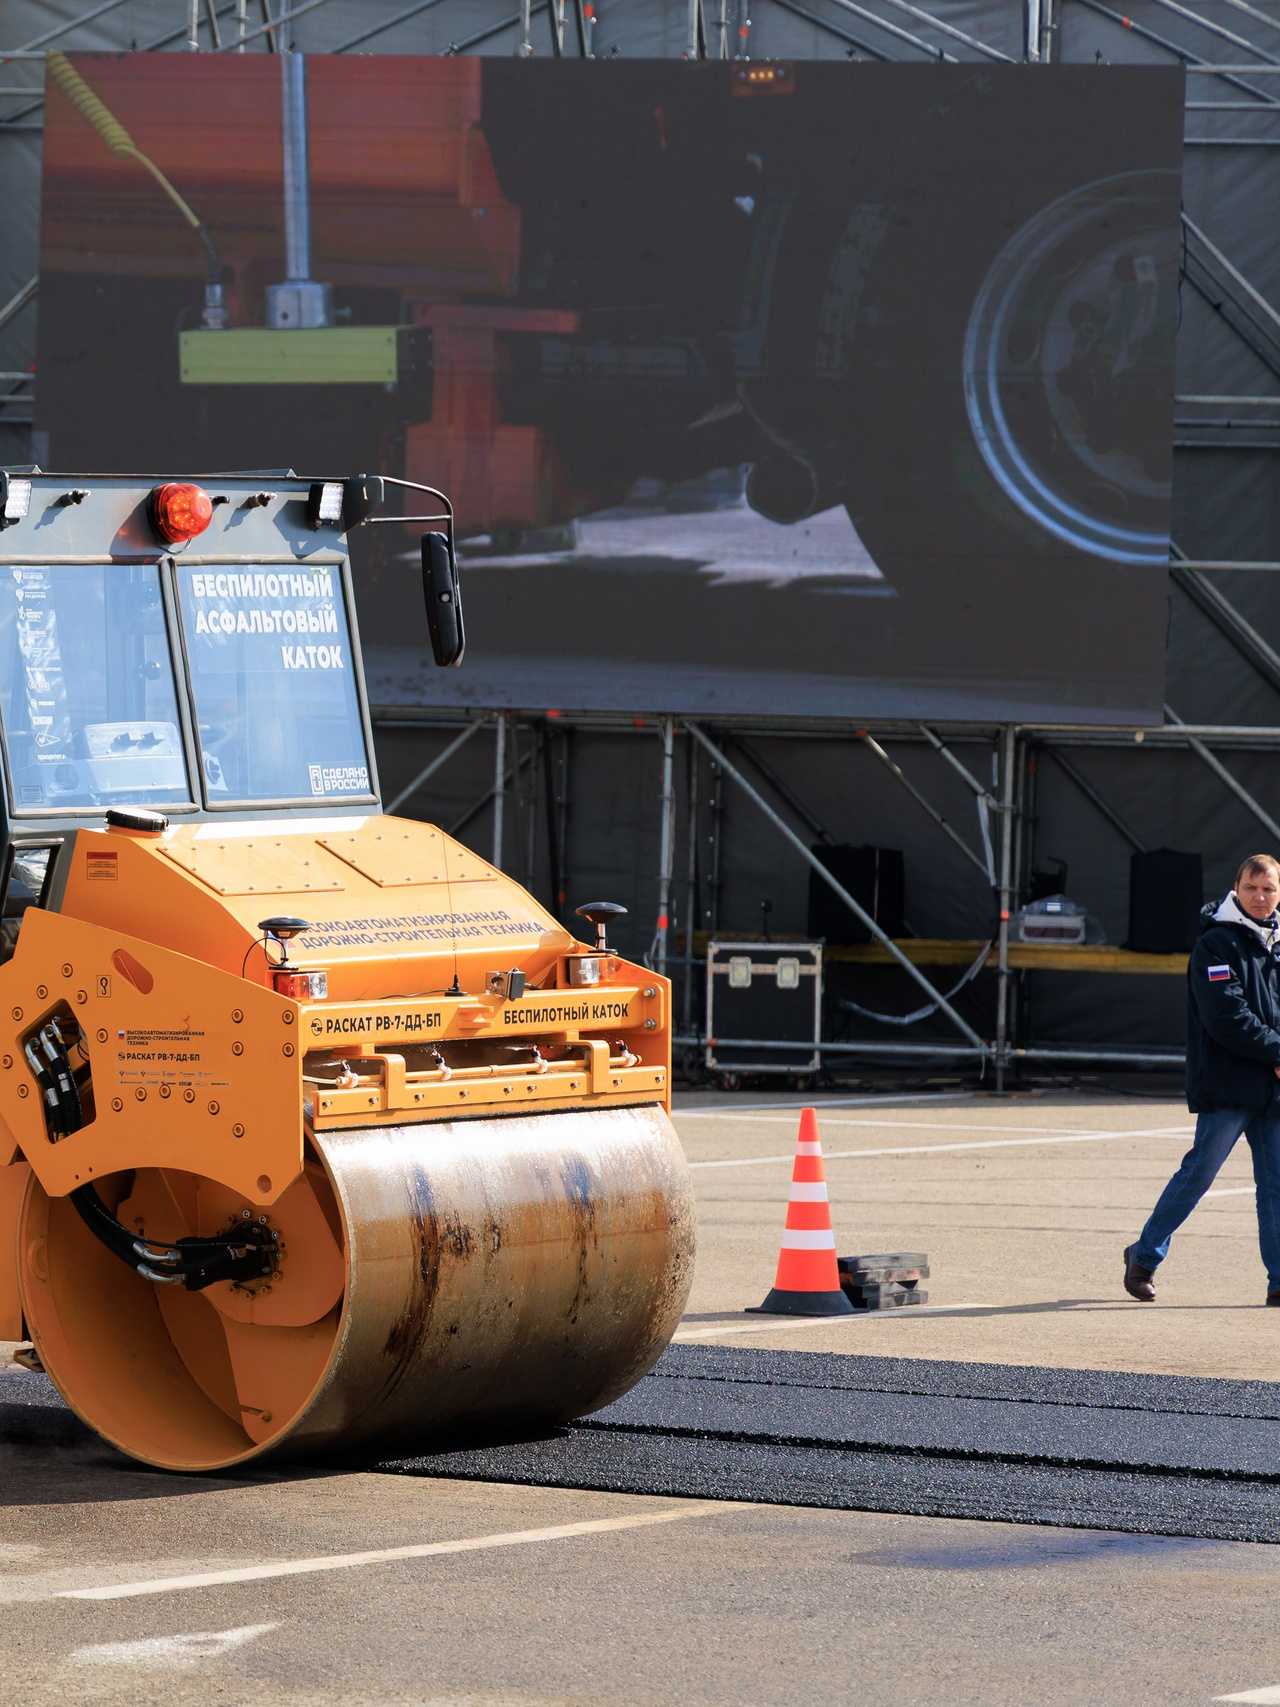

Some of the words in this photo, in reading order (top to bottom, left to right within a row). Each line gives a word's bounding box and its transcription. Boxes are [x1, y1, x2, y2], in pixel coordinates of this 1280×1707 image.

[192, 568, 333, 597] БЕСПИЛОТНЫЙ
[196, 603, 338, 634] АСФАЛЬТОВЫЙ
[282, 645, 344, 669] КАТОК
[323, 767, 368, 780] СДЕЛАНО
[300, 910, 511, 934] СОКОАВТОМАТИЗИРОВАННАЯ
[299, 925, 480, 950] ДОРОЖНО-СТРОИТЕЛЬНАЯ
[483, 921, 547, 936] ТЕХНИКА
[326, 1016, 372, 1034] РАСКАТ
[375, 1013, 441, 1031] РВ-7-ДД-БП
[504, 1002, 589, 1025] БЕСПИЛОТНЫЙ
[592, 1003, 628, 1019] КАТОК
[158, 1053, 200, 1062] РВ-7-ДД-БП
